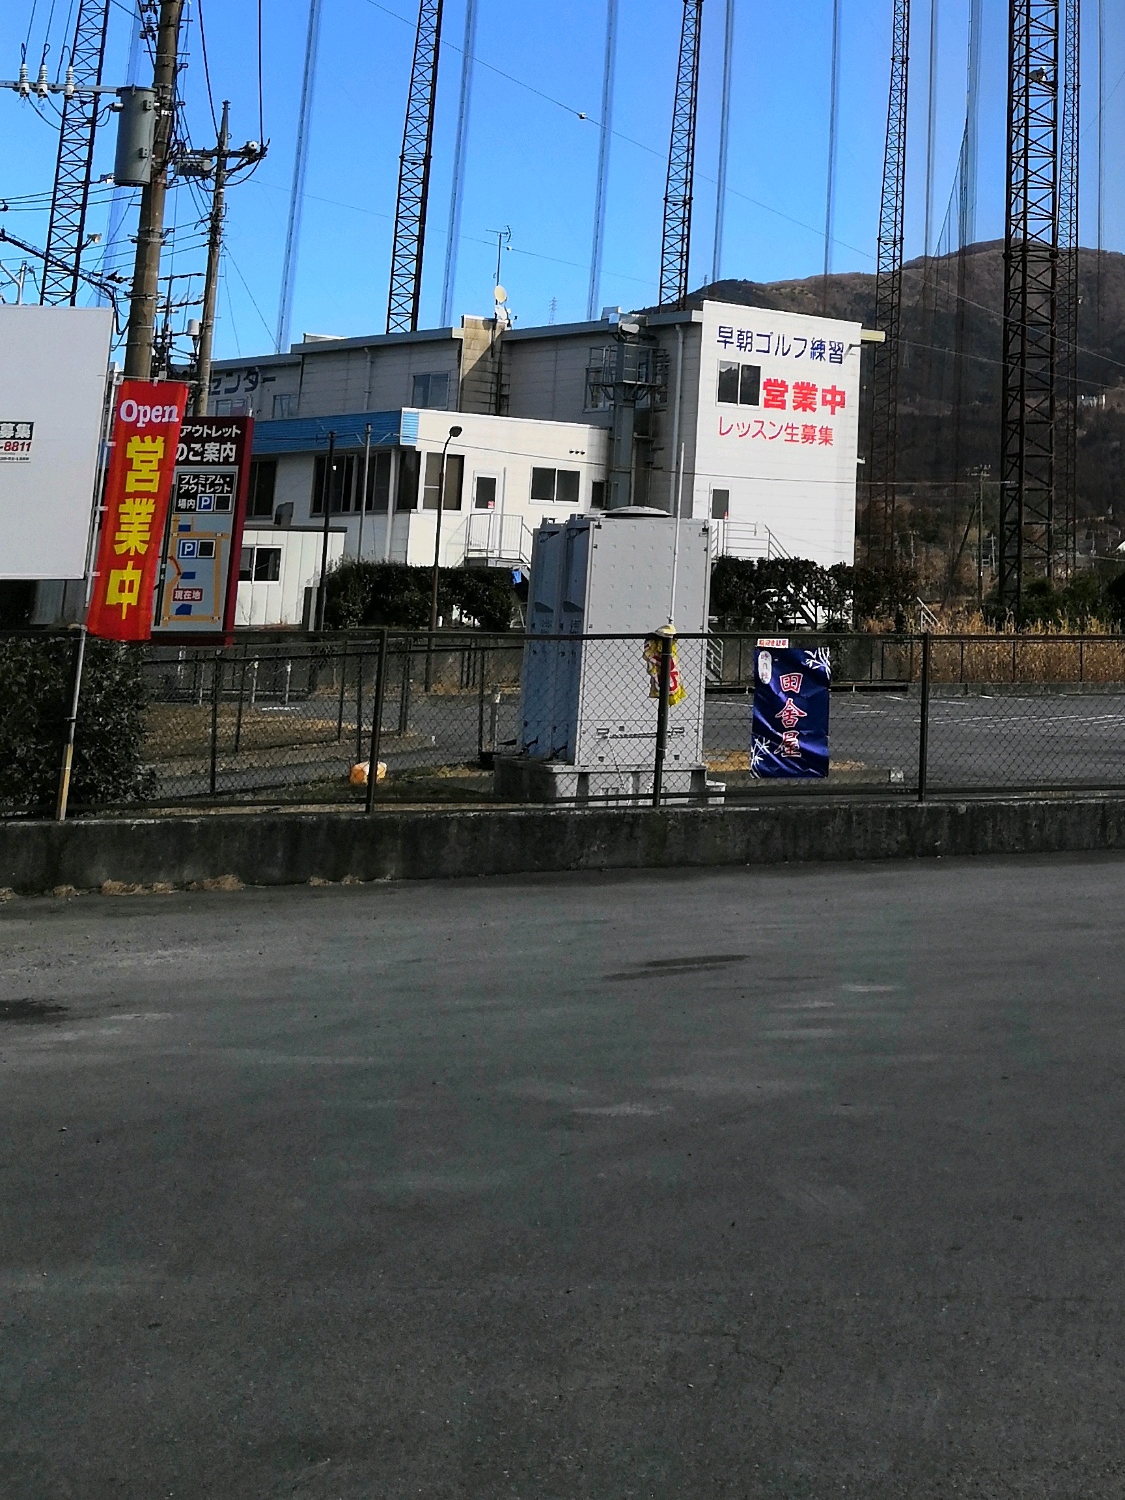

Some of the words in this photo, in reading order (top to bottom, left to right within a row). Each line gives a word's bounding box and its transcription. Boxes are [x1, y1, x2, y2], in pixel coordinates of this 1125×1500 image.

[716, 325, 844, 365] 早朝ゴルフ練習
[762, 377, 846, 416] 営業中
[119, 399, 180, 428] Open
[180, 424, 241, 438] アウトレット
[718, 416, 834, 446] レッスン生募集
[175, 441, 237, 463] のご案内
[180, 484, 231, 493] アウトレット
[105, 435, 165, 620] 営業中
[174, 589, 201, 600] 現在地
[774, 672, 807, 757] 田舎屋
